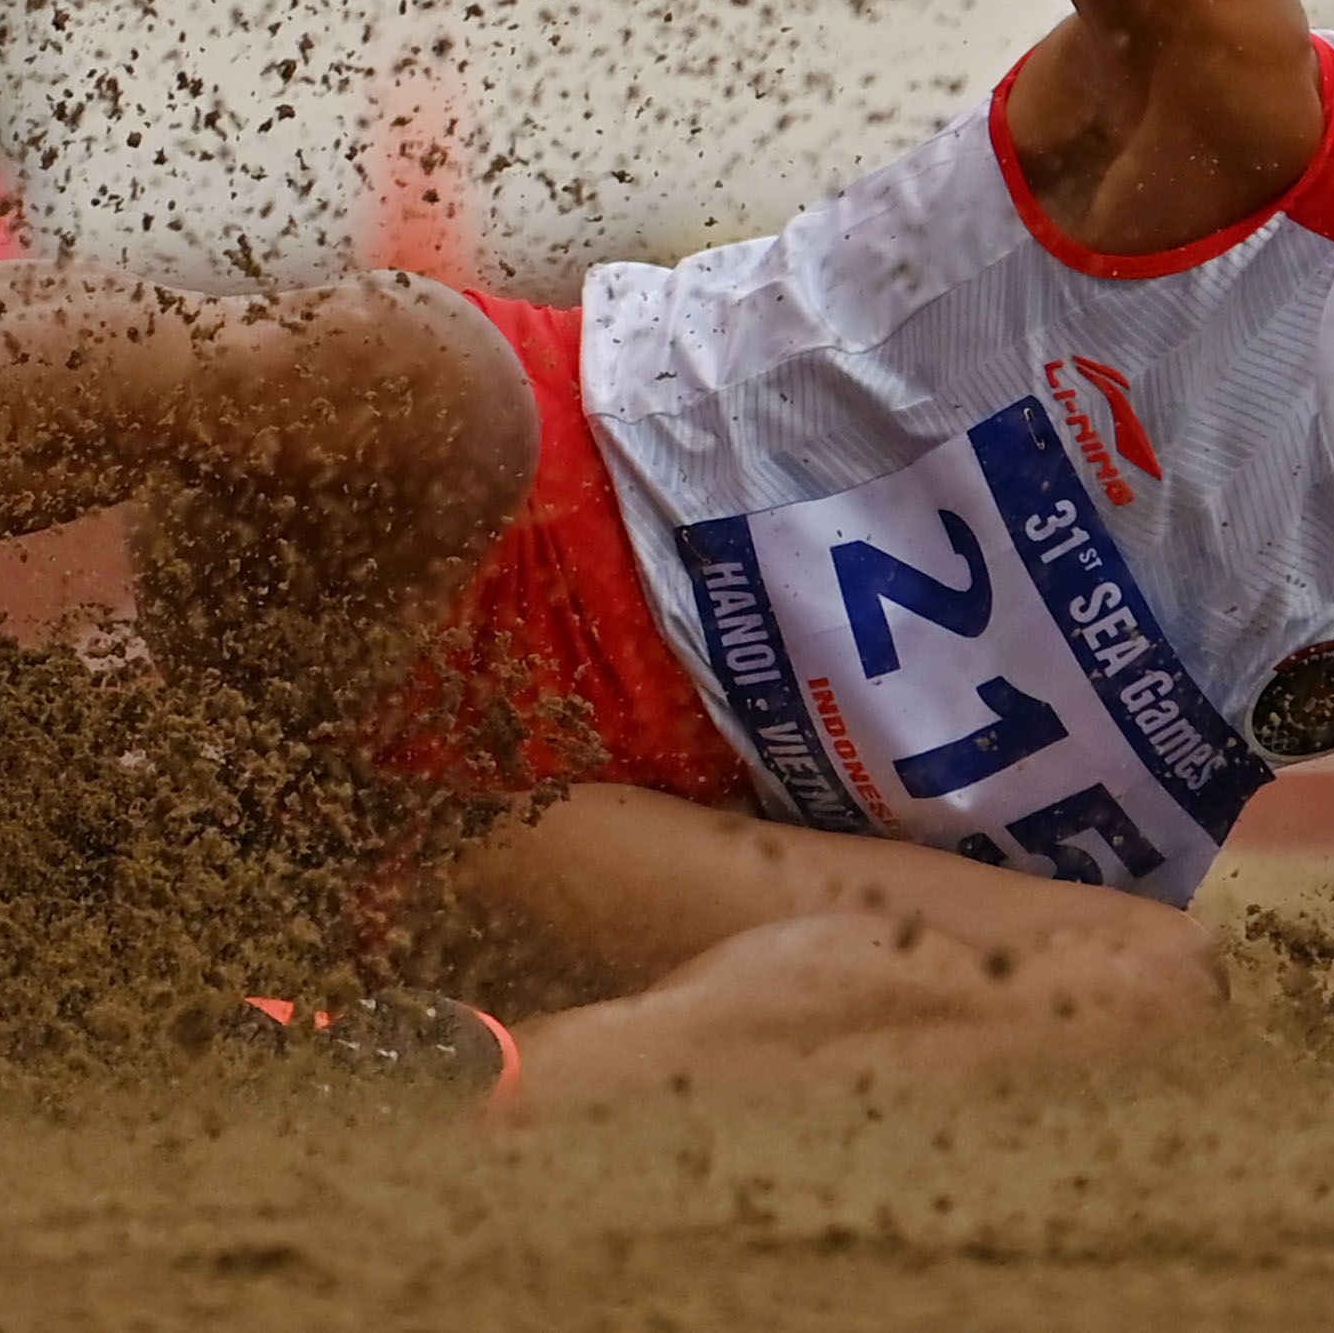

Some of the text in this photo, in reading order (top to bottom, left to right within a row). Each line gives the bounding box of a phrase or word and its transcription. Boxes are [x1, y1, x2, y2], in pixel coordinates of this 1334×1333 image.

[1044, 360, 1134, 505] LI-NING
[703, 562, 781, 686] HANOI
[758, 721, 853, 820] VIETN
[830, 509, 1165, 885] 215
[1069, 582, 1150, 678] SEA
[1120, 669, 1226, 791] Games
